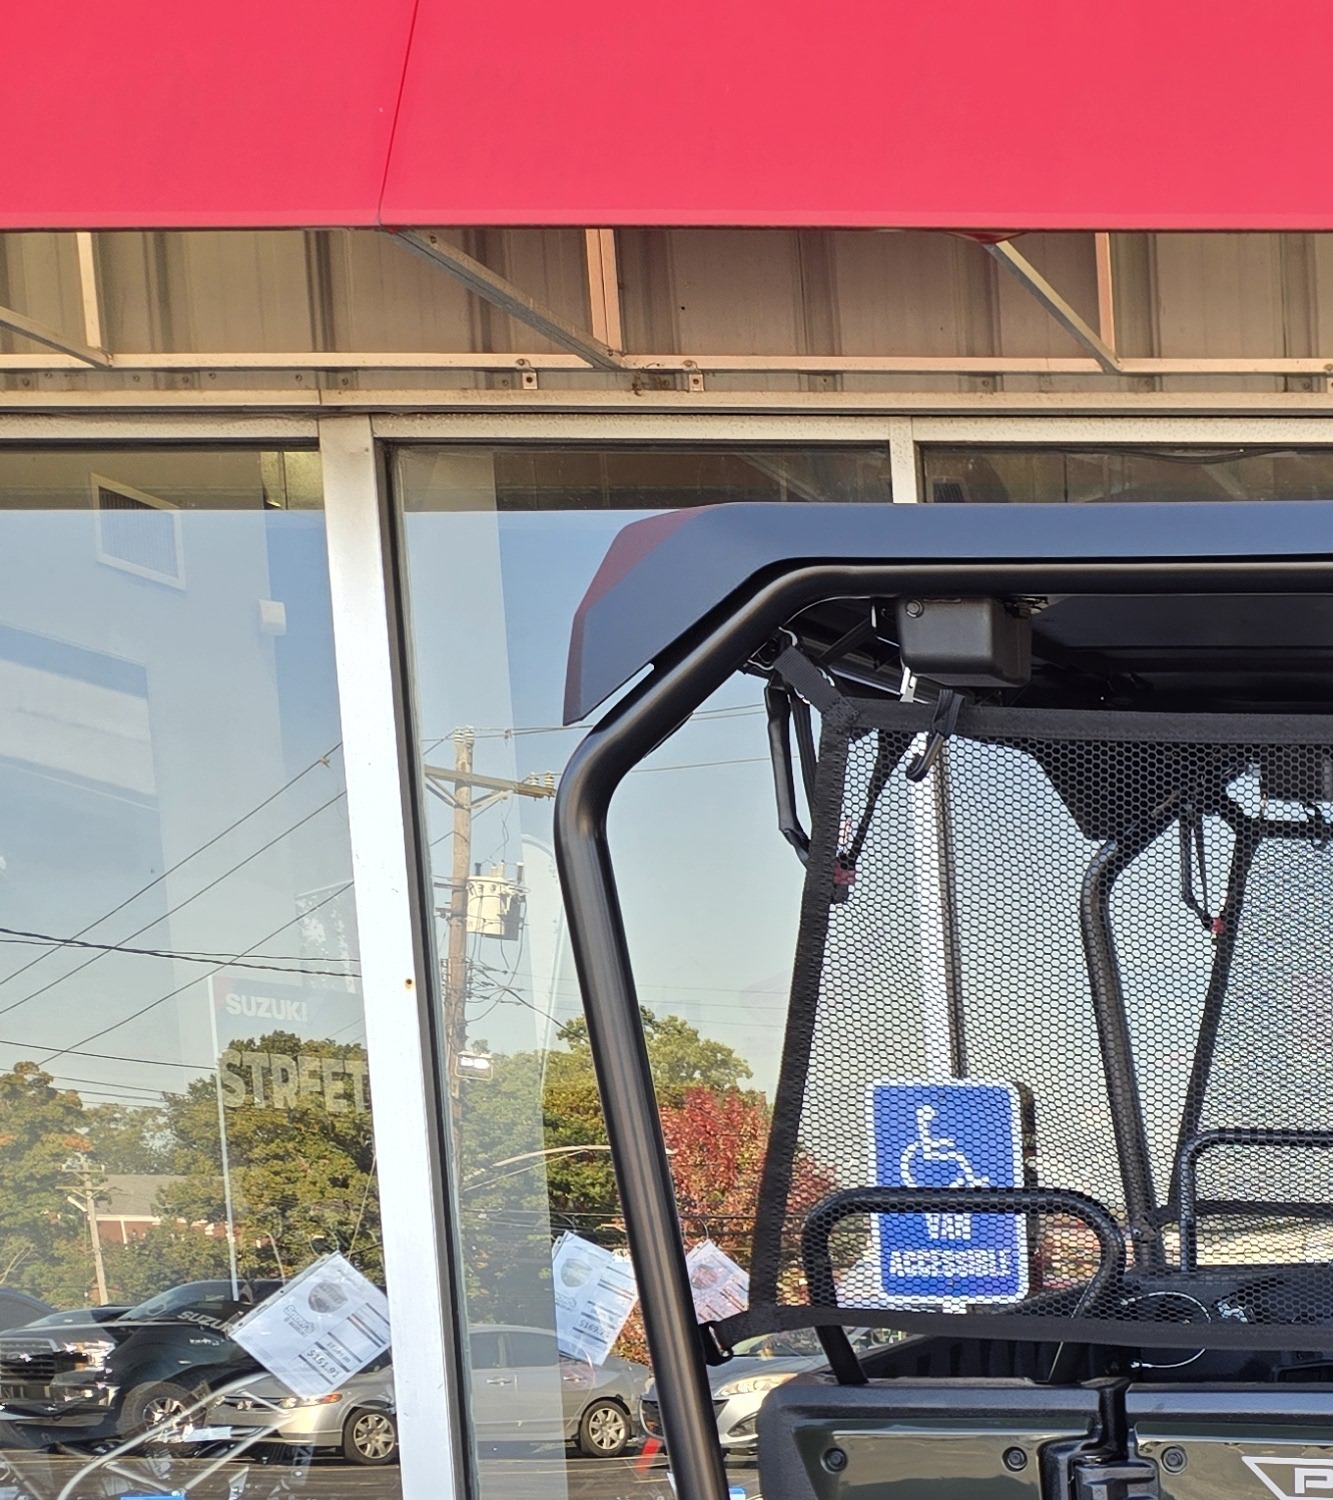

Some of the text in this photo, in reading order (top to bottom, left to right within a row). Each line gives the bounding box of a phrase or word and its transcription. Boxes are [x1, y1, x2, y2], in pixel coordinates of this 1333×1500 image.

[225, 992, 308, 1022] SUZUKI
[218, 1048, 369, 1114] STREET
[307, 1350, 341, 1379] $151.91
